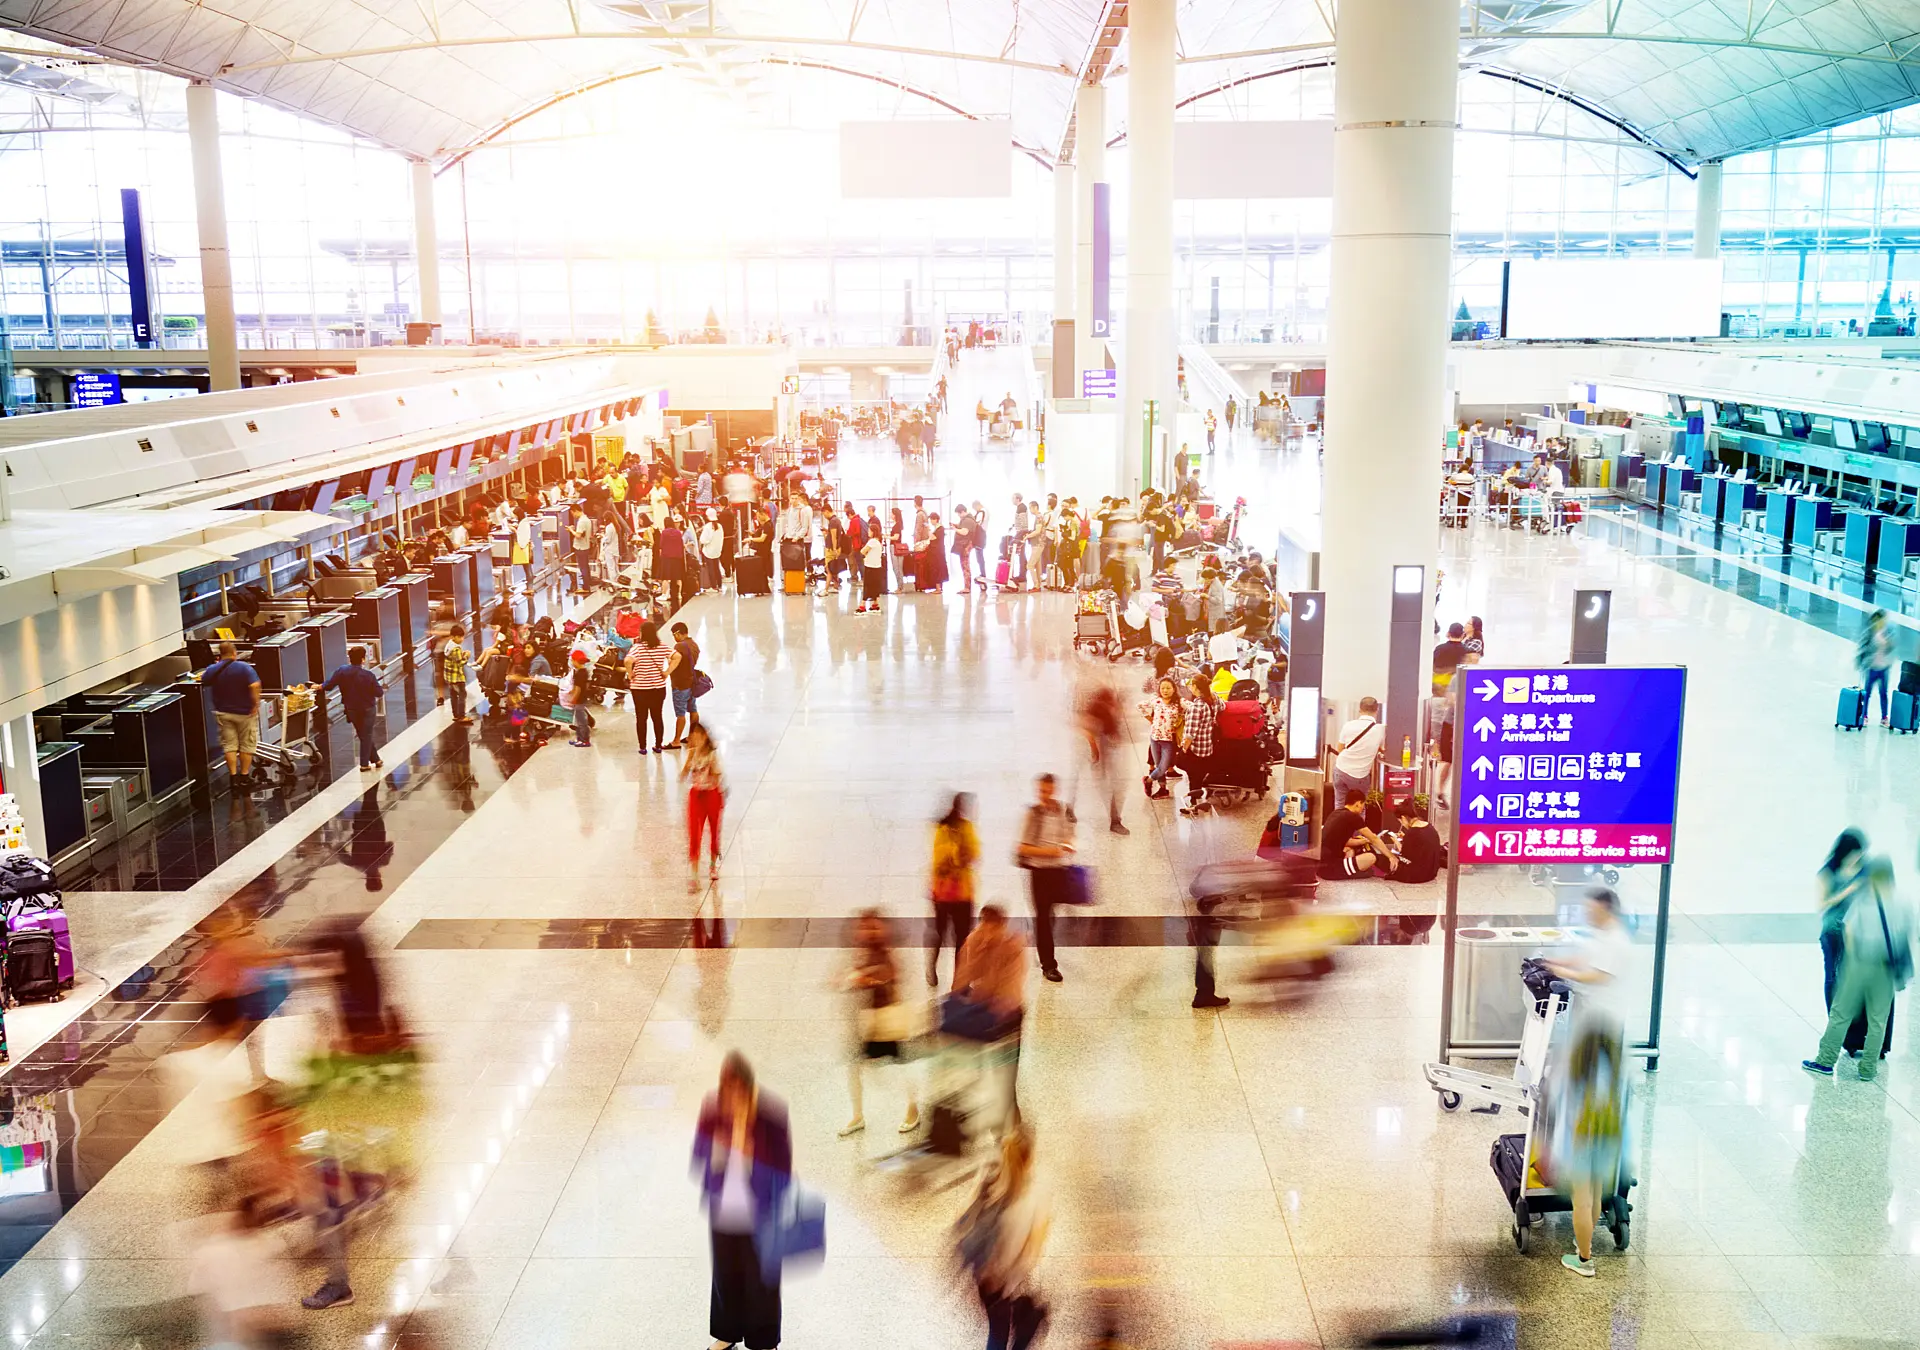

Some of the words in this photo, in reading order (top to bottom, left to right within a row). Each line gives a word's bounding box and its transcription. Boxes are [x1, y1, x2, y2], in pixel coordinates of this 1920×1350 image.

[137, 324, 147, 336] E
[1095, 320, 1107, 332] D
[1532, 693, 1596, 704] Departures
[1501, 731, 1546, 742] Arrivals
[1549, 731, 1570, 742] Hall
[1588, 769, 1601, 780] To
[1604, 769, 1626, 782] city
[1503, 797, 1519, 816] P
[1526, 808, 1545, 818] Car
[1549, 808, 1580, 818] Parks
[1524, 846, 1580, 856] Customer
[1582, 846, 1625, 856] Service
